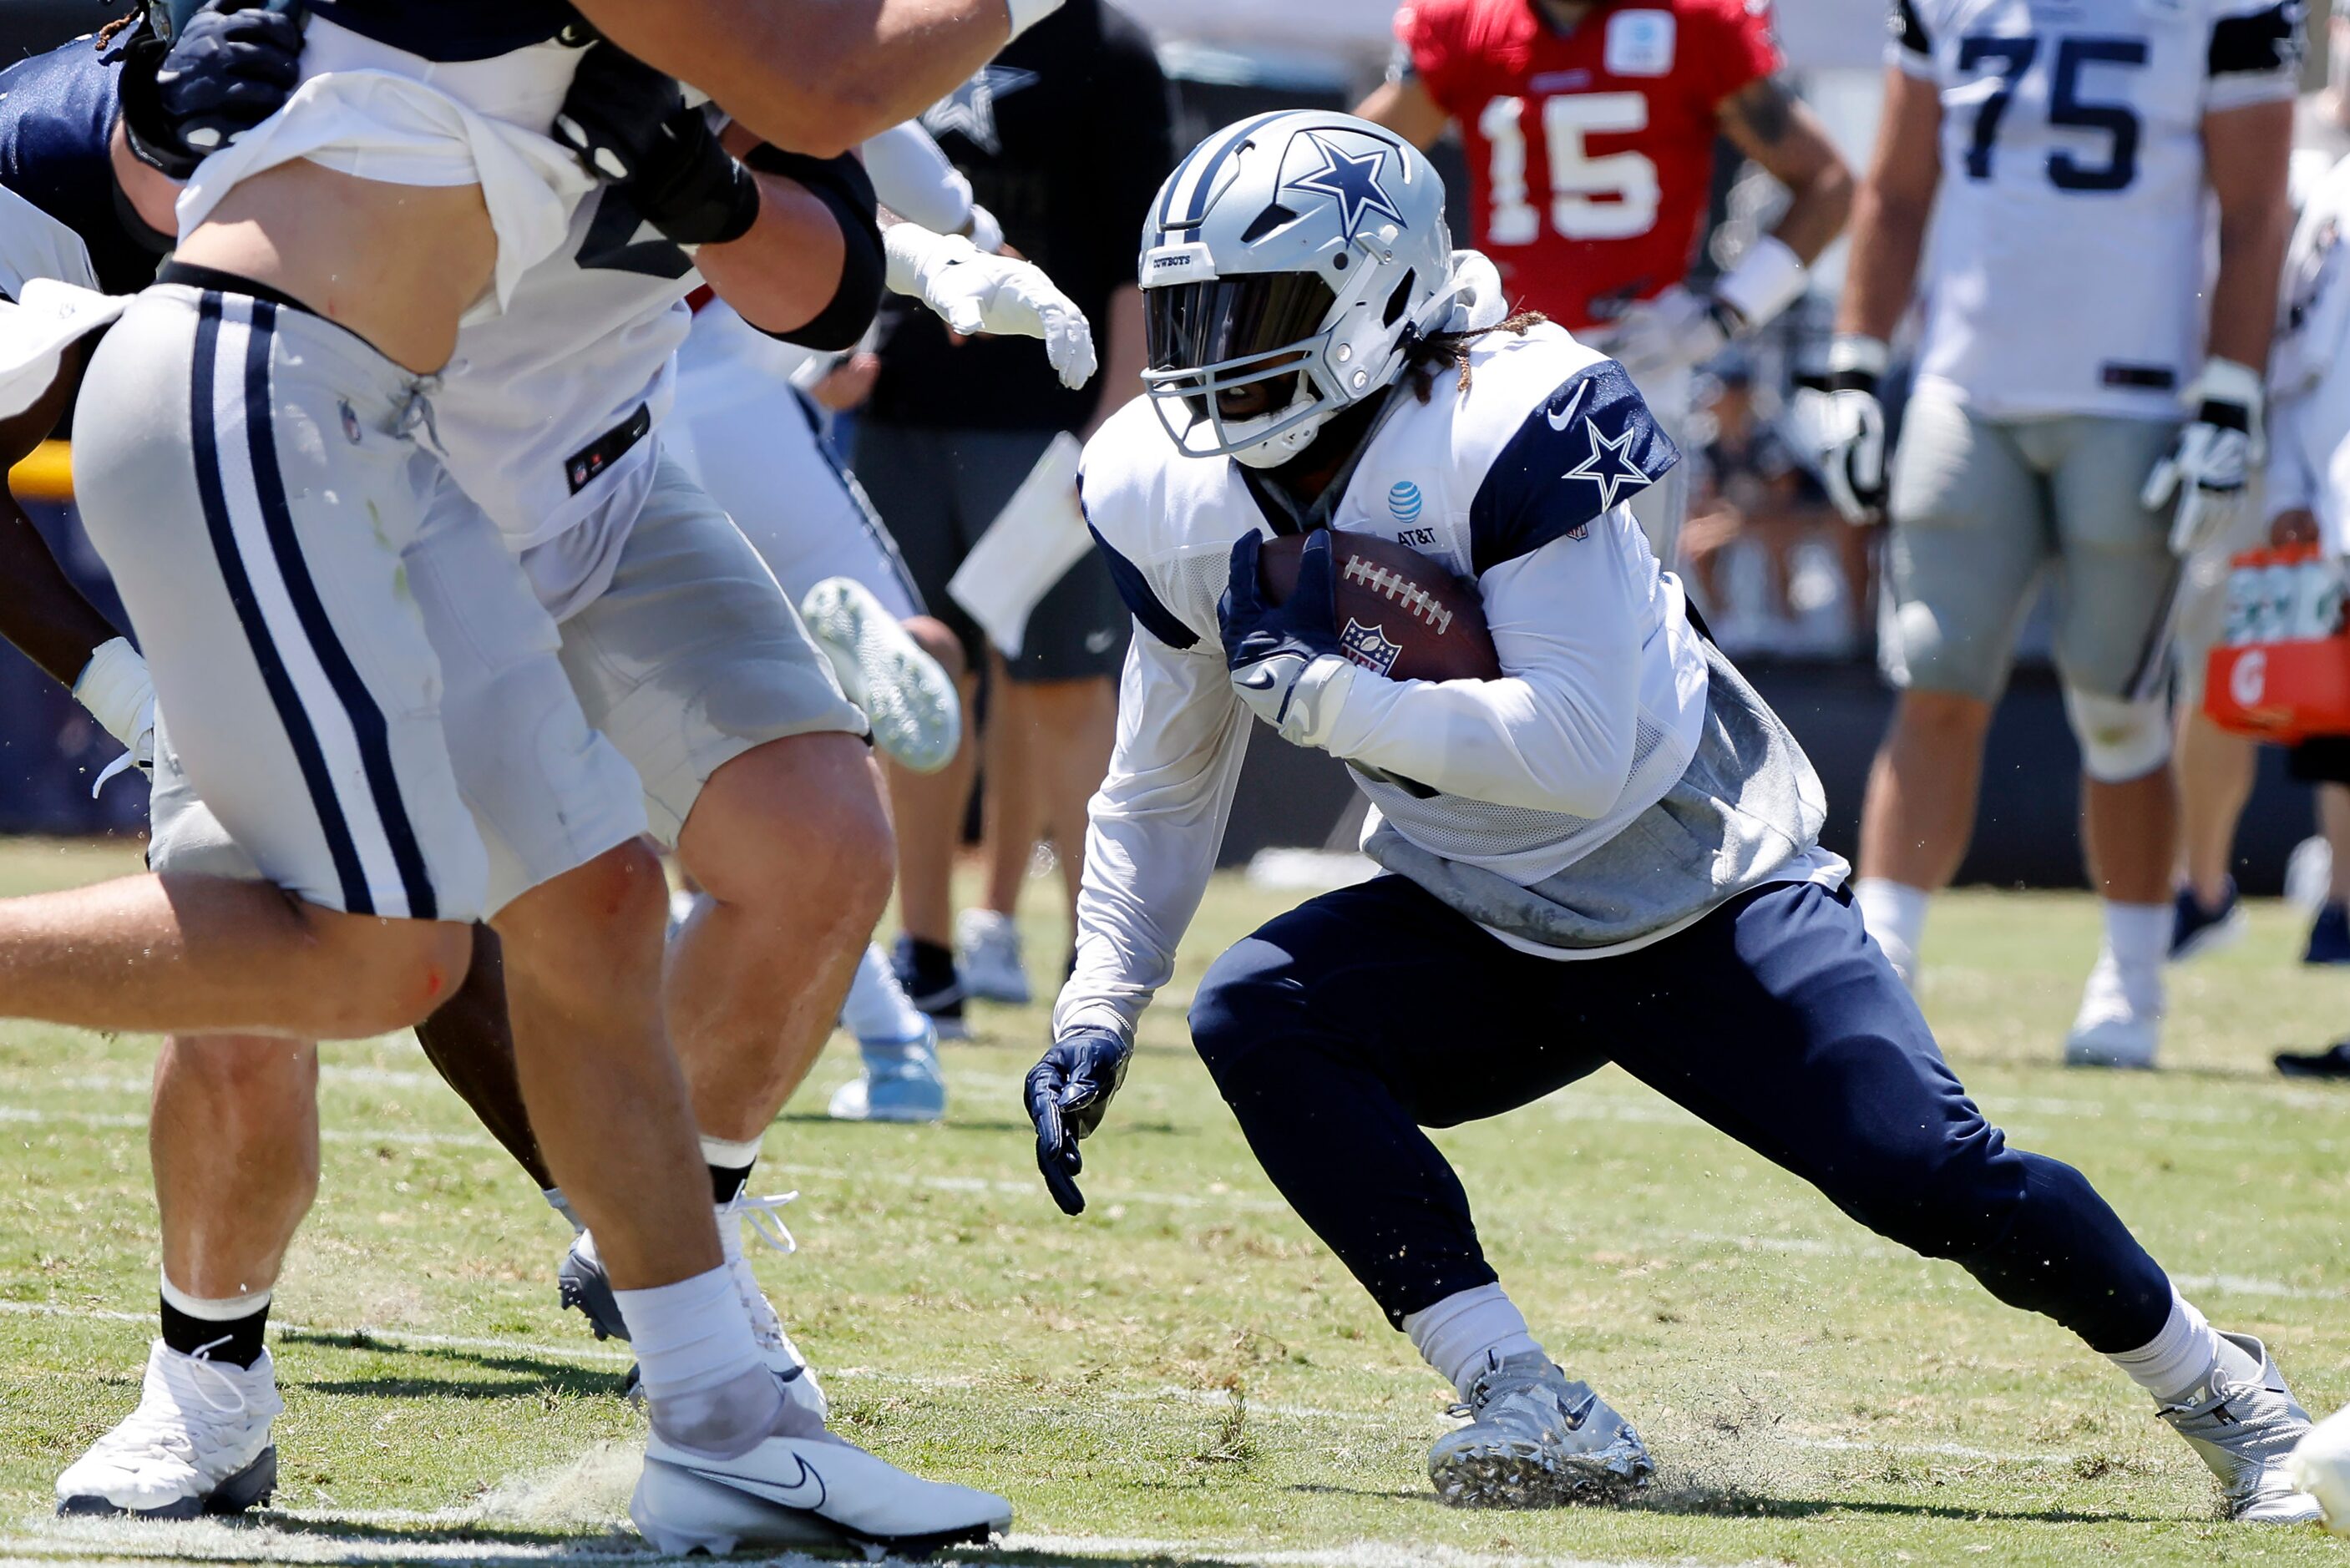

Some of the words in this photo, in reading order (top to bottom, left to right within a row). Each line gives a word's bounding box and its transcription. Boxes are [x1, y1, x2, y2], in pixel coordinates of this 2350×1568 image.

[1957, 36, 2147, 191] 75
[1478, 91, 1663, 245] 15
[1153, 255, 1191, 268] COWBOYS
[1397, 527, 1436, 547] AT&T
[2229, 649, 2267, 708] G
